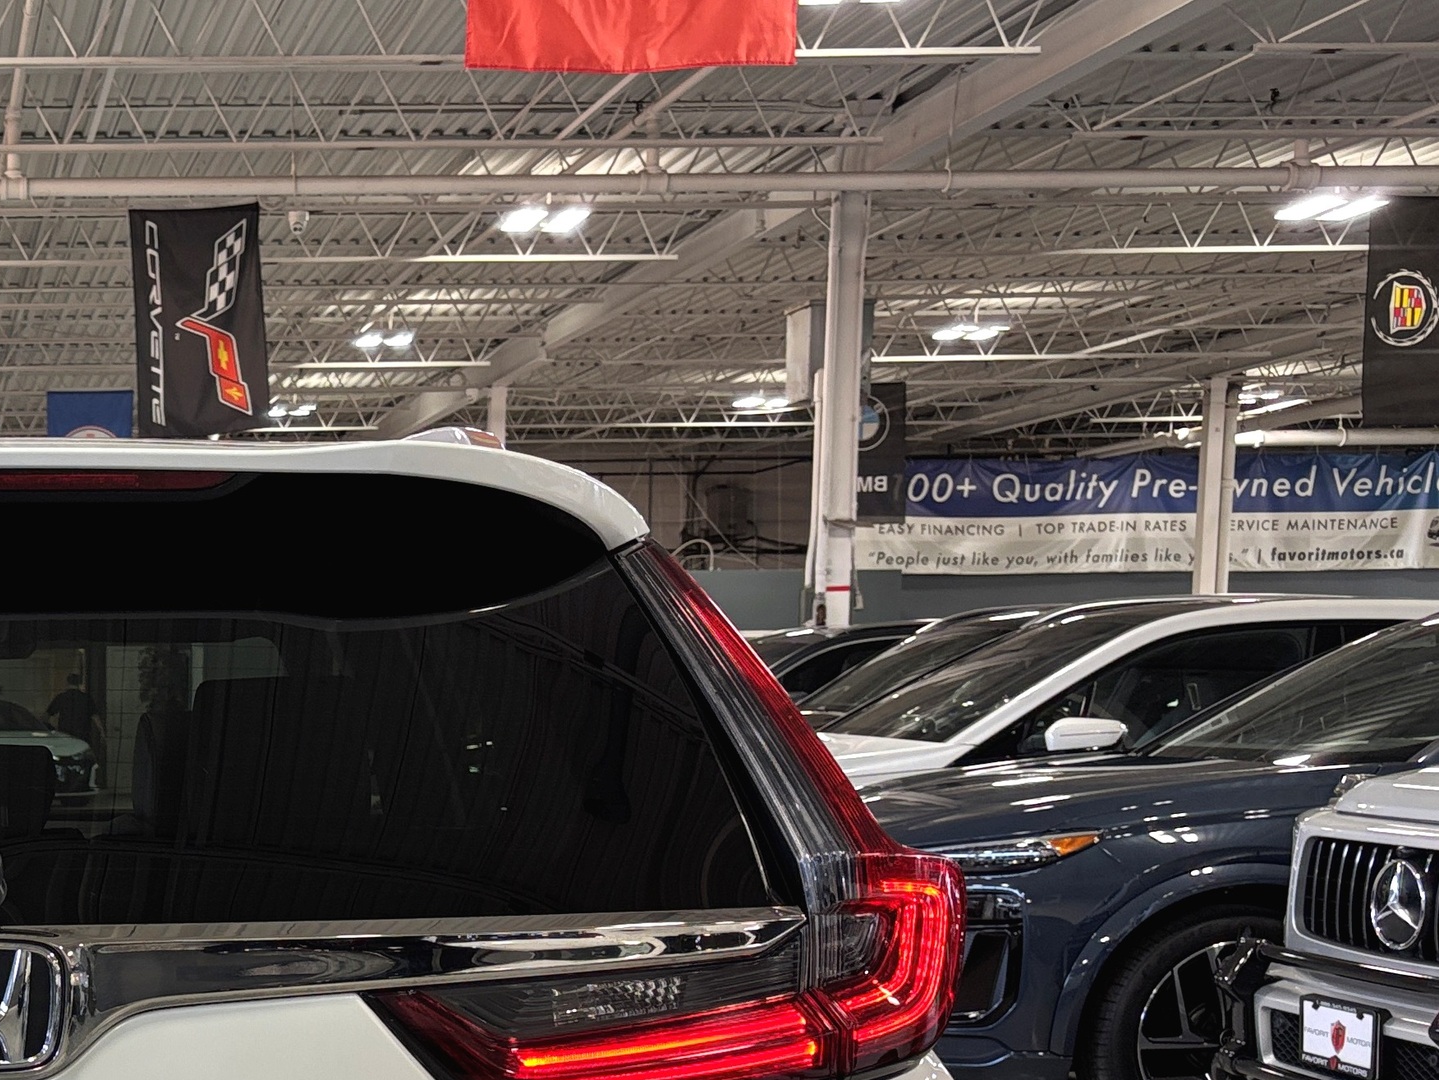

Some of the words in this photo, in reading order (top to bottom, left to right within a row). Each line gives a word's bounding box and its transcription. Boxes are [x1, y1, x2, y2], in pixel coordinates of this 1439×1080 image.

[145, 219, 166, 426] CORVETTE
[992, 468, 1119, 508] Quality
[1332, 461, 1439, 497] Vehicl
[877, 523, 915, 536] EASY
[920, 523, 1005, 537] FINANCING
[1035, 523, 1065, 535] TOP
[1071, 520, 1137, 534] TRADE-IN
[1144, 519, 1187, 532] RATES
[1229, 519, 1279, 532] ERVICE
[1286, 516, 1399, 532] MAINTENANCE
[935, 551, 966, 568] just
[972, 551, 1000, 566] like
[1005, 555, 1039, 570] you,
[1046, 551, 1078, 565] with
[1085, 549, 1148, 566] families
[1154, 547, 1182, 563] like
[1270, 546, 1405, 562] favoritmotors.ca
[1301, 1053, 1328, 1067] FAVORIT
[1338, 1063, 1368, 1078] MOTORS
